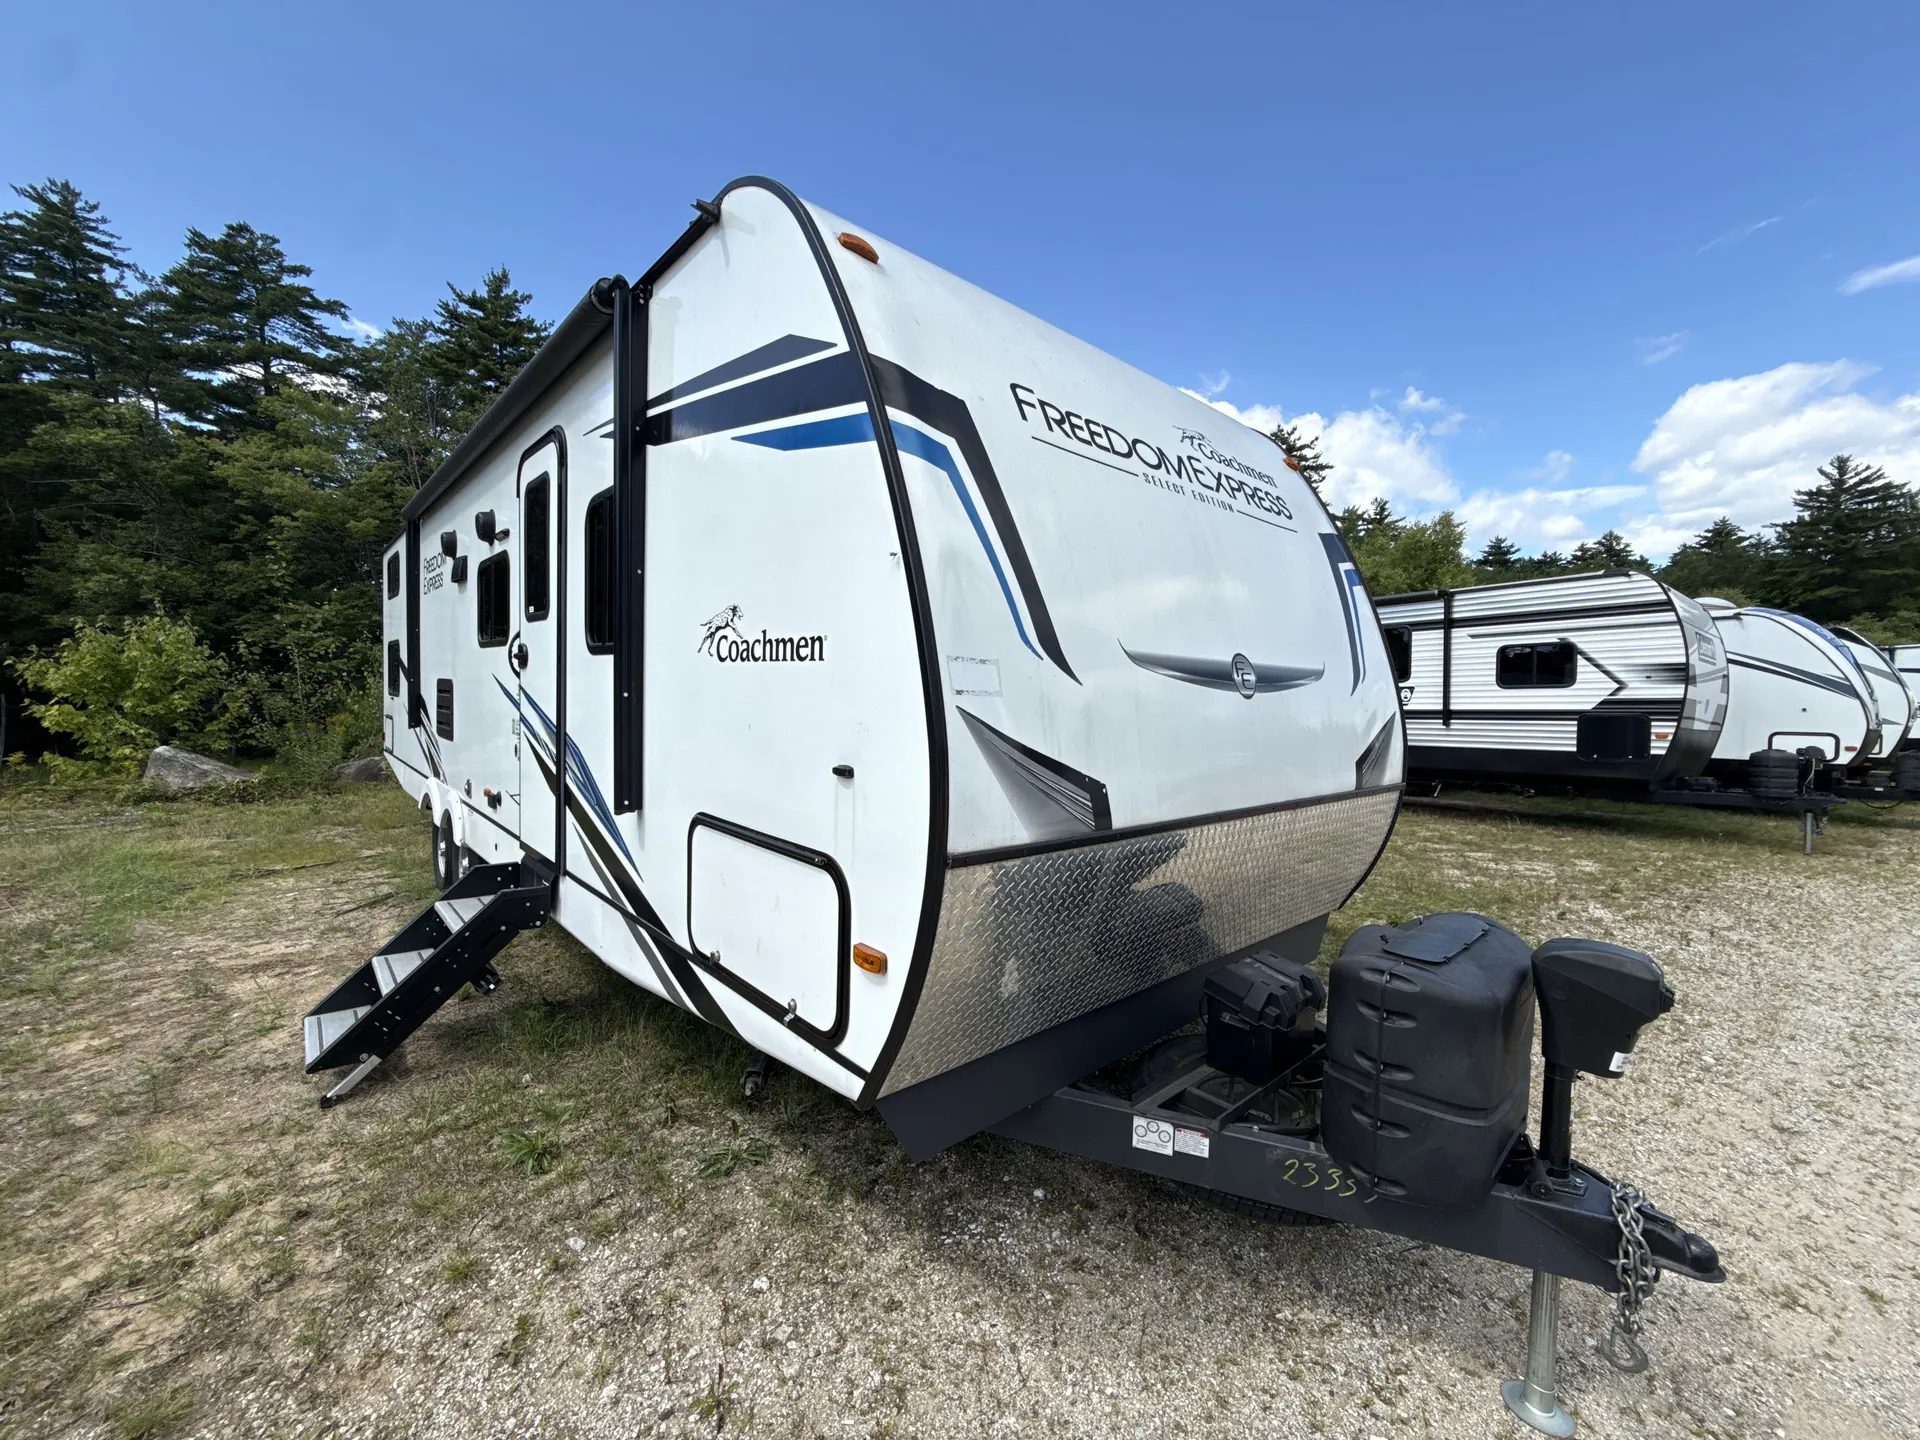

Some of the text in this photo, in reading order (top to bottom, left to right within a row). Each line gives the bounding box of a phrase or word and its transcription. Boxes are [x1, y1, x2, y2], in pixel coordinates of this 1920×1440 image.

[1197, 442, 1279, 488] Coachmen
[1142, 472, 1235, 513] SELECT EDITION
[423, 571, 444, 595] EXPRESS
[716, 629, 825, 663] Coachmen
